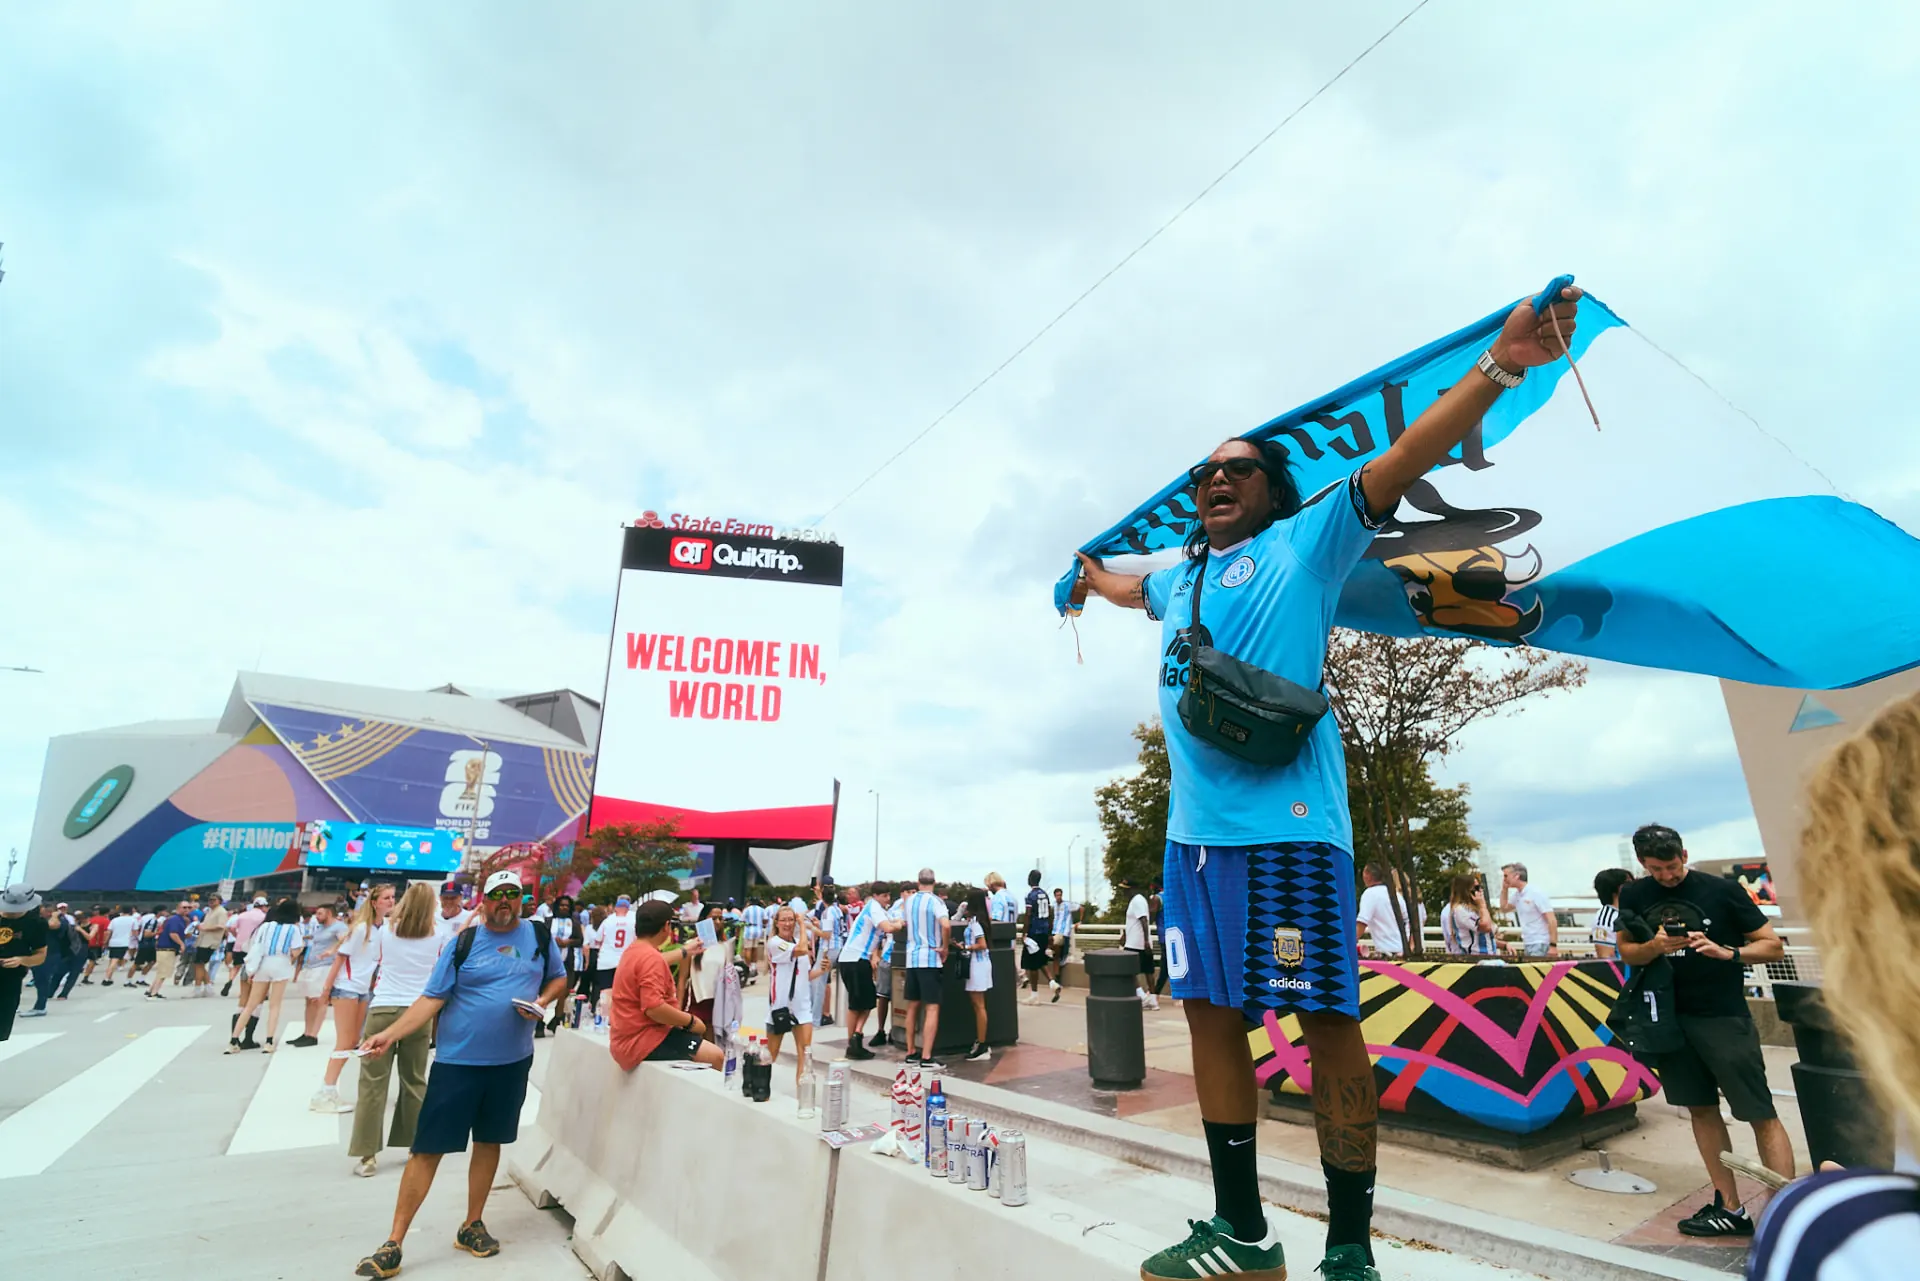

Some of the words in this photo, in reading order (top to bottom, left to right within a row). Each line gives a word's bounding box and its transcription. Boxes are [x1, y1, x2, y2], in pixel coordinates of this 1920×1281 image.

[668, 513, 722, 534] State
[723, 517, 774, 538] Farm
[779, 527, 838, 544] ARENA
[673, 541, 706, 565] QT
[626, 632, 782, 678] WELCOME
[788, 643, 827, 686] IN,
[1159, 662, 1191, 687] Mac
[669, 680, 782, 722] WORLD
[436, 818, 471, 827] WORLD
[614, 929, 626, 948] 9
[1269, 977, 1312, 990] adidas
[947, 1143, 967, 1151] TRA
